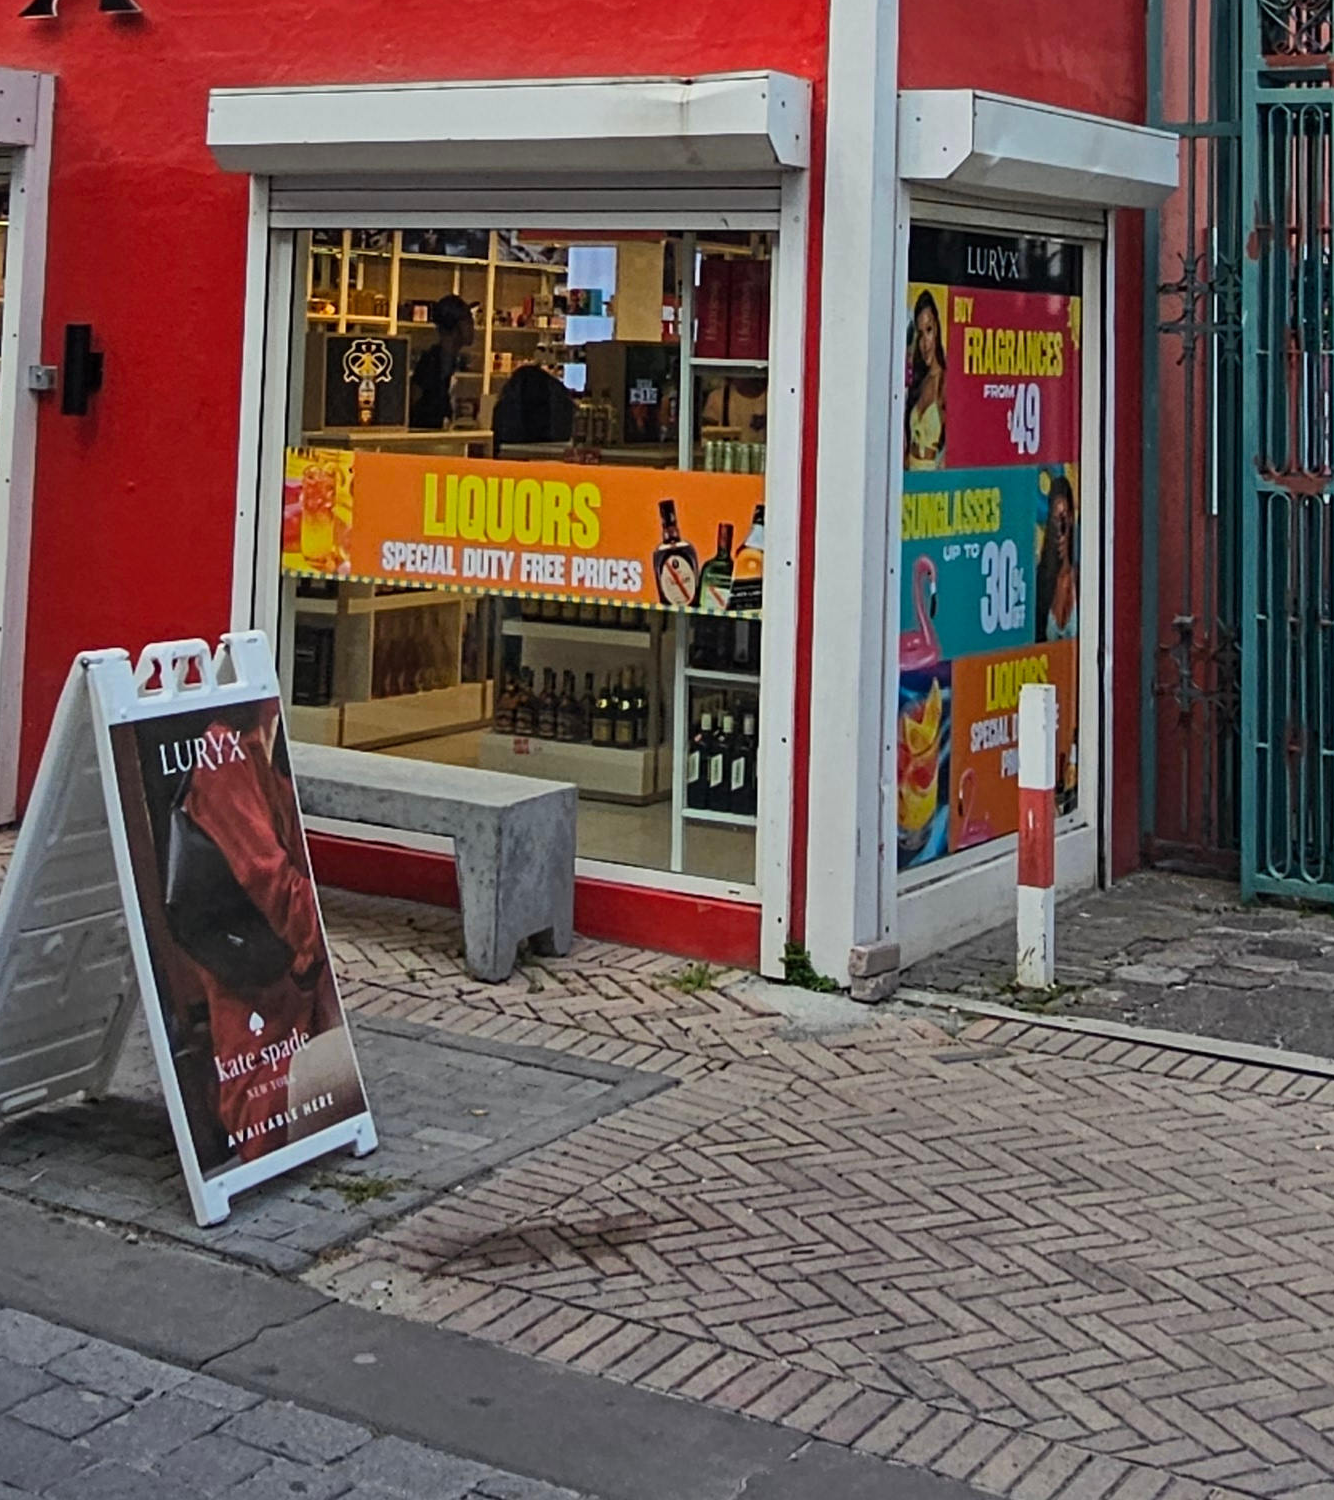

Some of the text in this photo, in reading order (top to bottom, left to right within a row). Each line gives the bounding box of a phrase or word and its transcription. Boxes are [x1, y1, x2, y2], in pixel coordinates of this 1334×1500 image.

[966, 246, 1019, 282] LURYX
[953, 296, 974, 324] BUY
[964, 327, 1064, 377] FRAGRANCES
[983, 384, 1015, 399] FROM
[423, 472, 602, 550] LIQUORS
[901, 486, 1001, 540] SUNGLASSES
[382, 540, 643, 593] SPECIAL DUTY FREE PRICES
[943, 542, 980, 562] UP TO
[159, 730, 246, 776] LURYX
[214, 1027, 310, 1082] kate spade
[247, 1083, 268, 1101] NEW
[227, 1092, 335, 1148] AVAILABLE HERE
